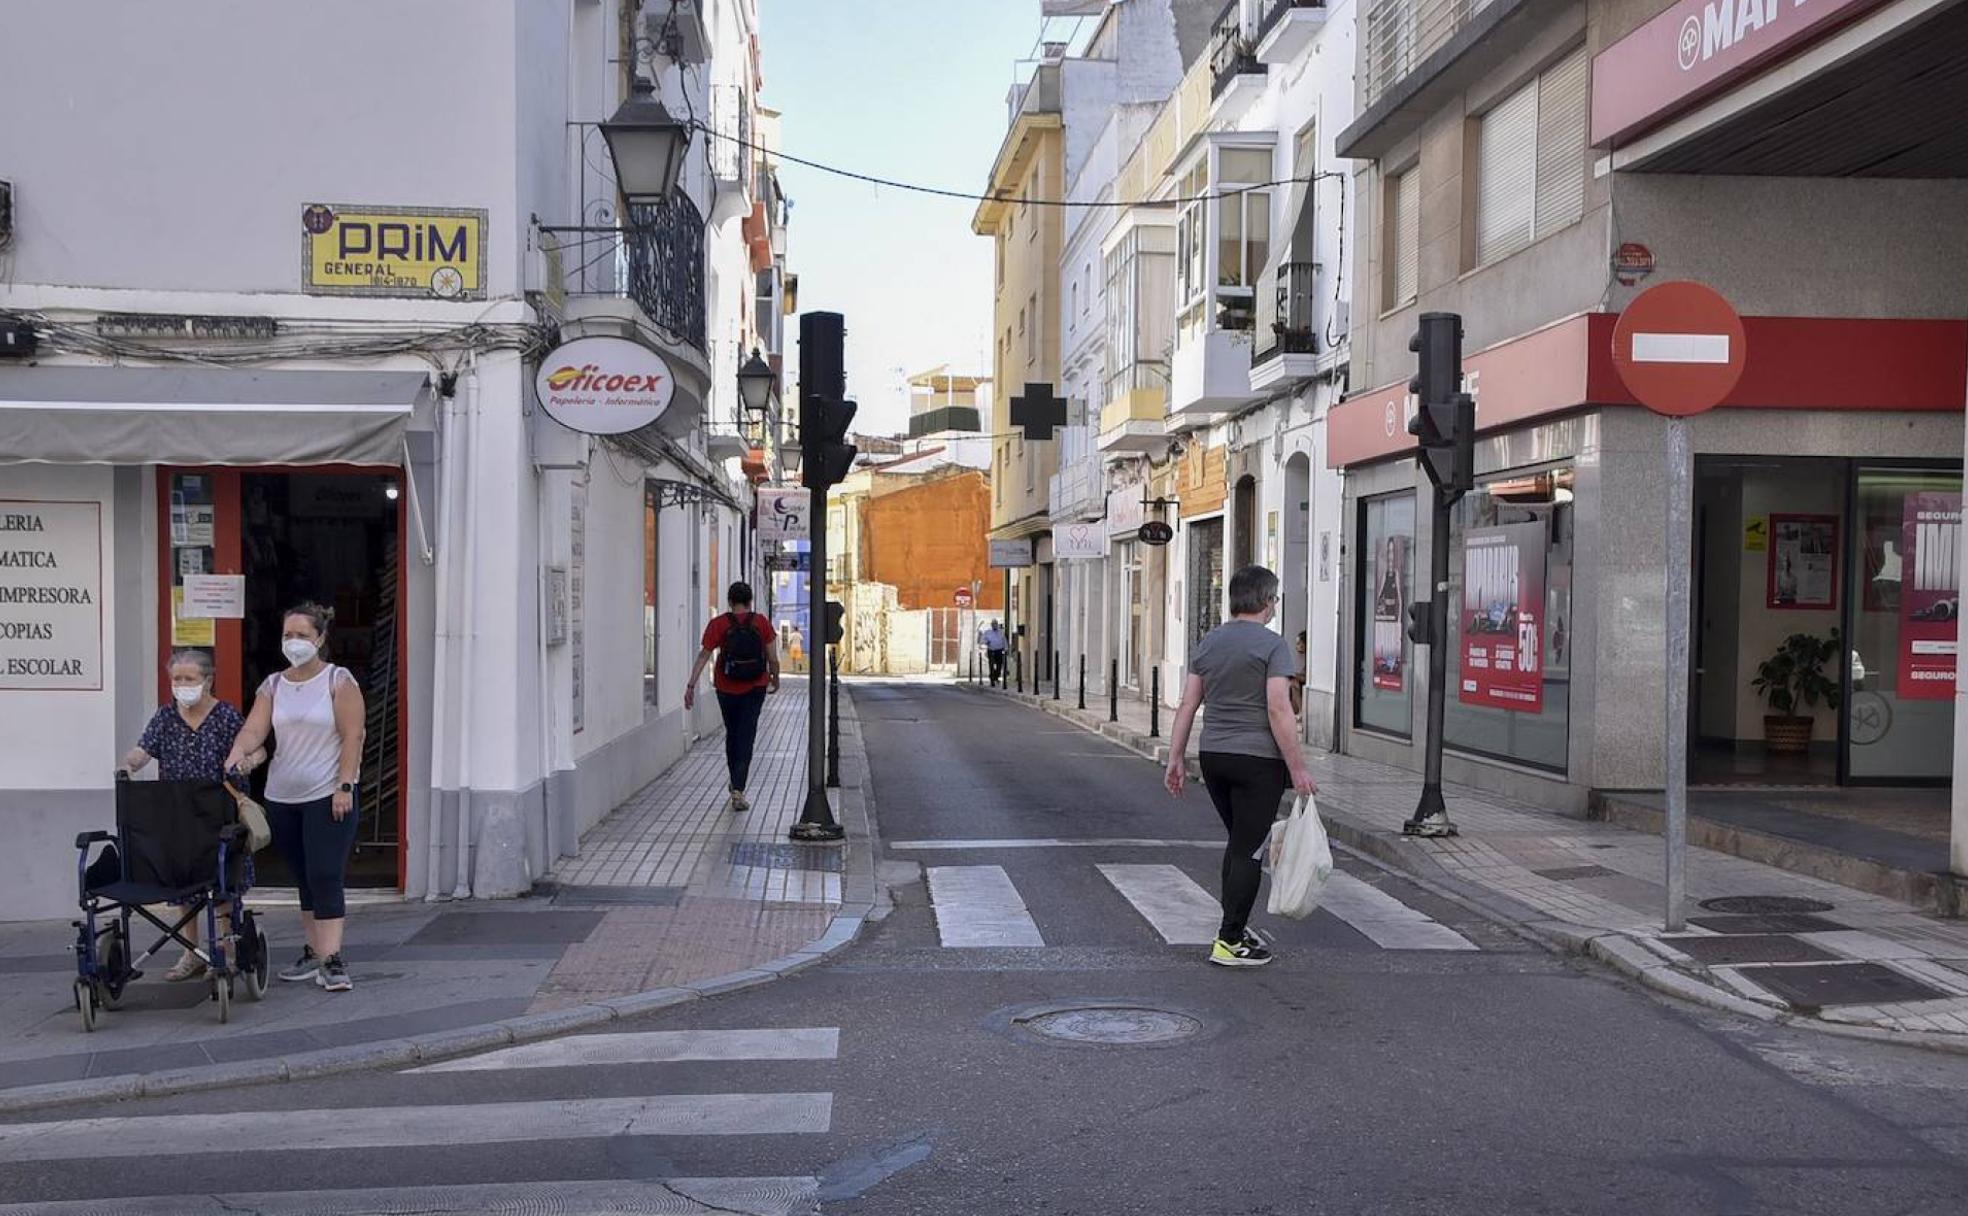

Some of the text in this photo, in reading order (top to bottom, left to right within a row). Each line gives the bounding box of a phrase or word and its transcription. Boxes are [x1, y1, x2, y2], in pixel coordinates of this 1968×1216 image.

[1702, 0, 1807, 61] MA
[324, 261, 396, 276] GENERAL
[547, 363, 664, 392] Oficoex
[8, 659, 83, 675] ESCOLAR
